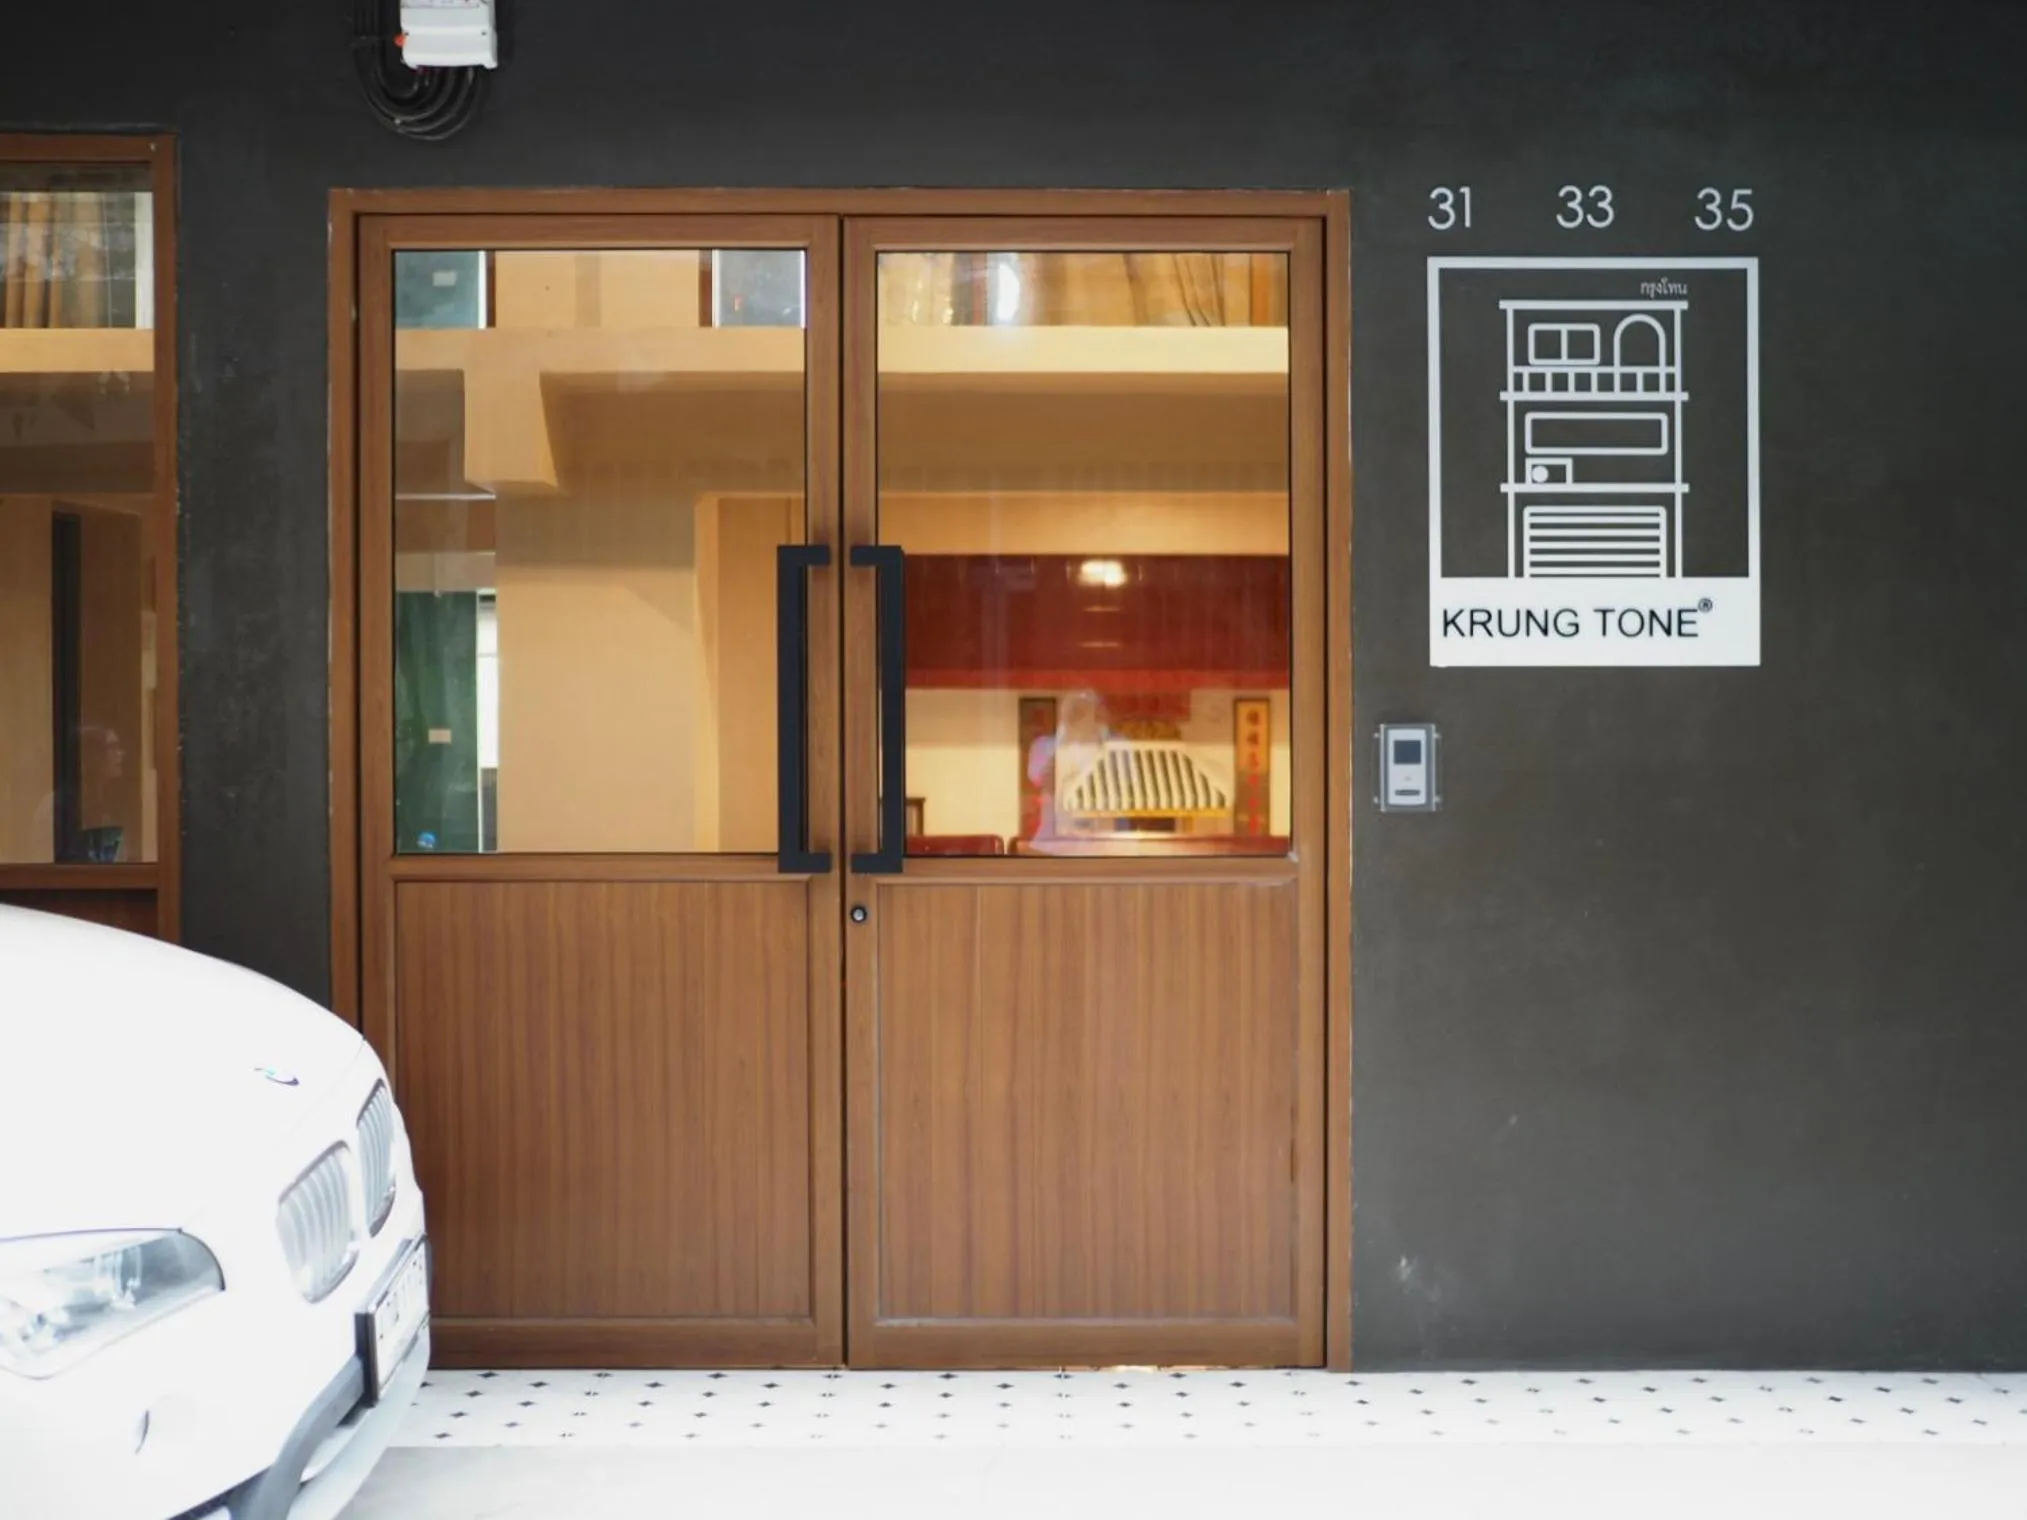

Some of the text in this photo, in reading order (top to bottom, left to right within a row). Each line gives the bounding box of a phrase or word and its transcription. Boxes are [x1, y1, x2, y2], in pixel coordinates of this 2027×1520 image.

[1427, 185, 1754, 231] 31 33 35
[1640, 276, 1688, 298] กรุงโทน
[1443, 608, 1580, 638] KRUNG
